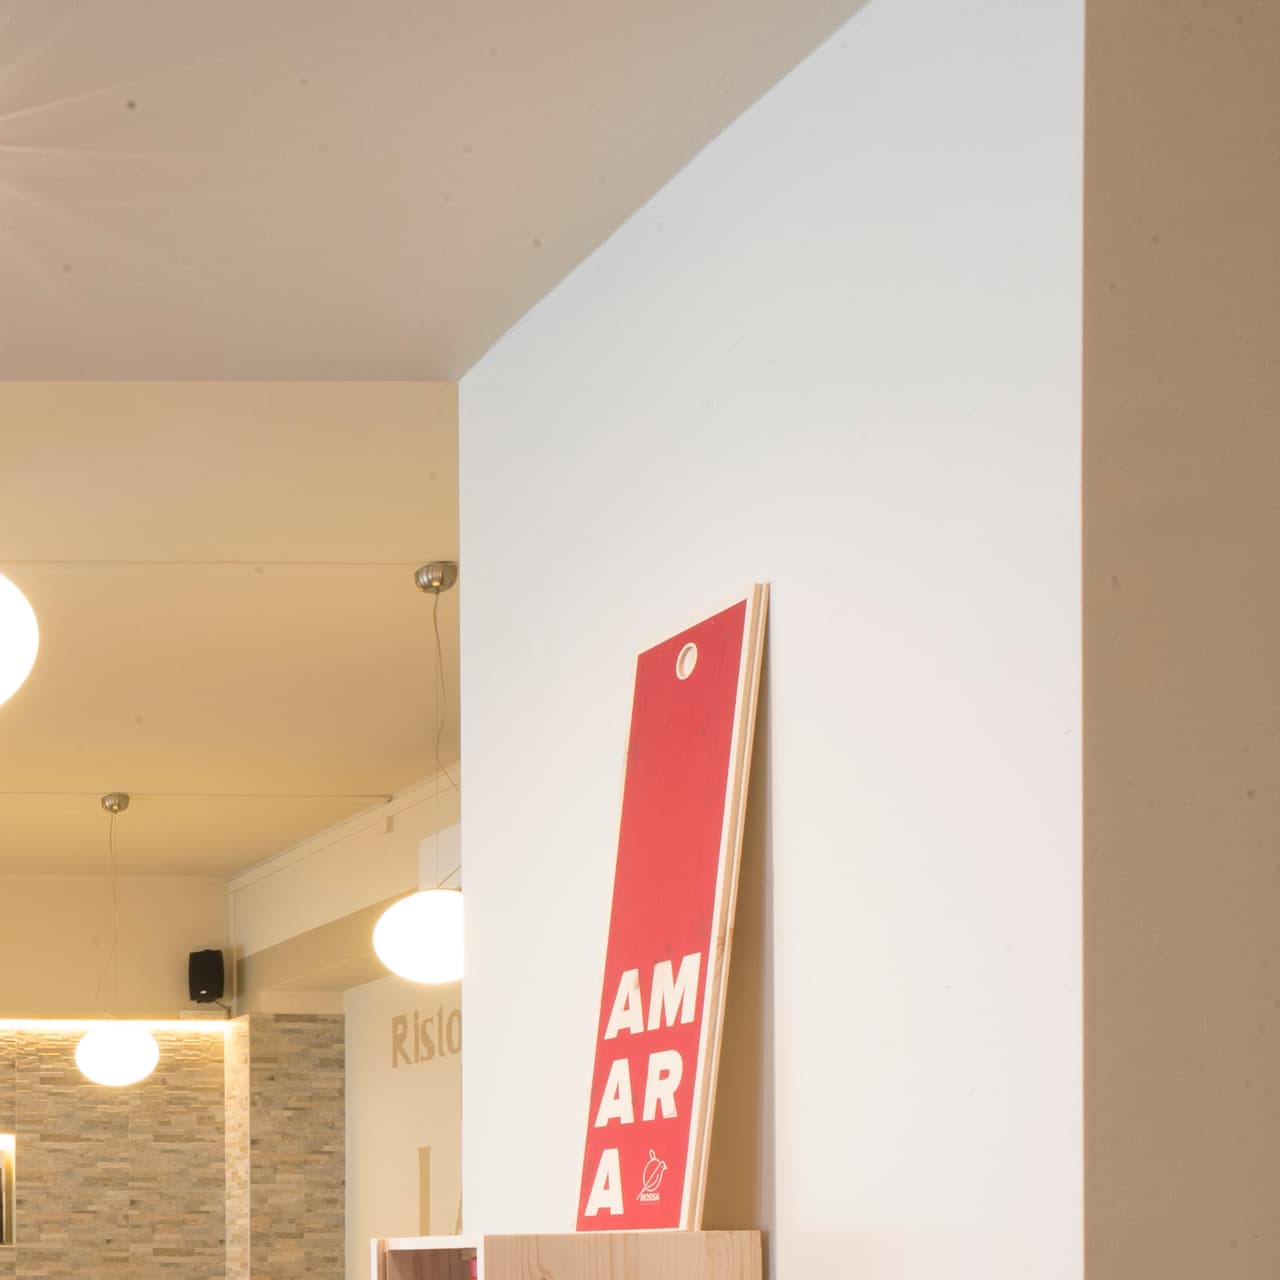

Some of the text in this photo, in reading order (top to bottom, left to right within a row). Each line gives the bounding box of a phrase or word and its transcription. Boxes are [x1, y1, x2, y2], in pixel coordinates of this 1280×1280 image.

[604, 953, 701, 1040] AM
[594, 1050, 684, 1128] AR
[584, 1148, 625, 1217] A
